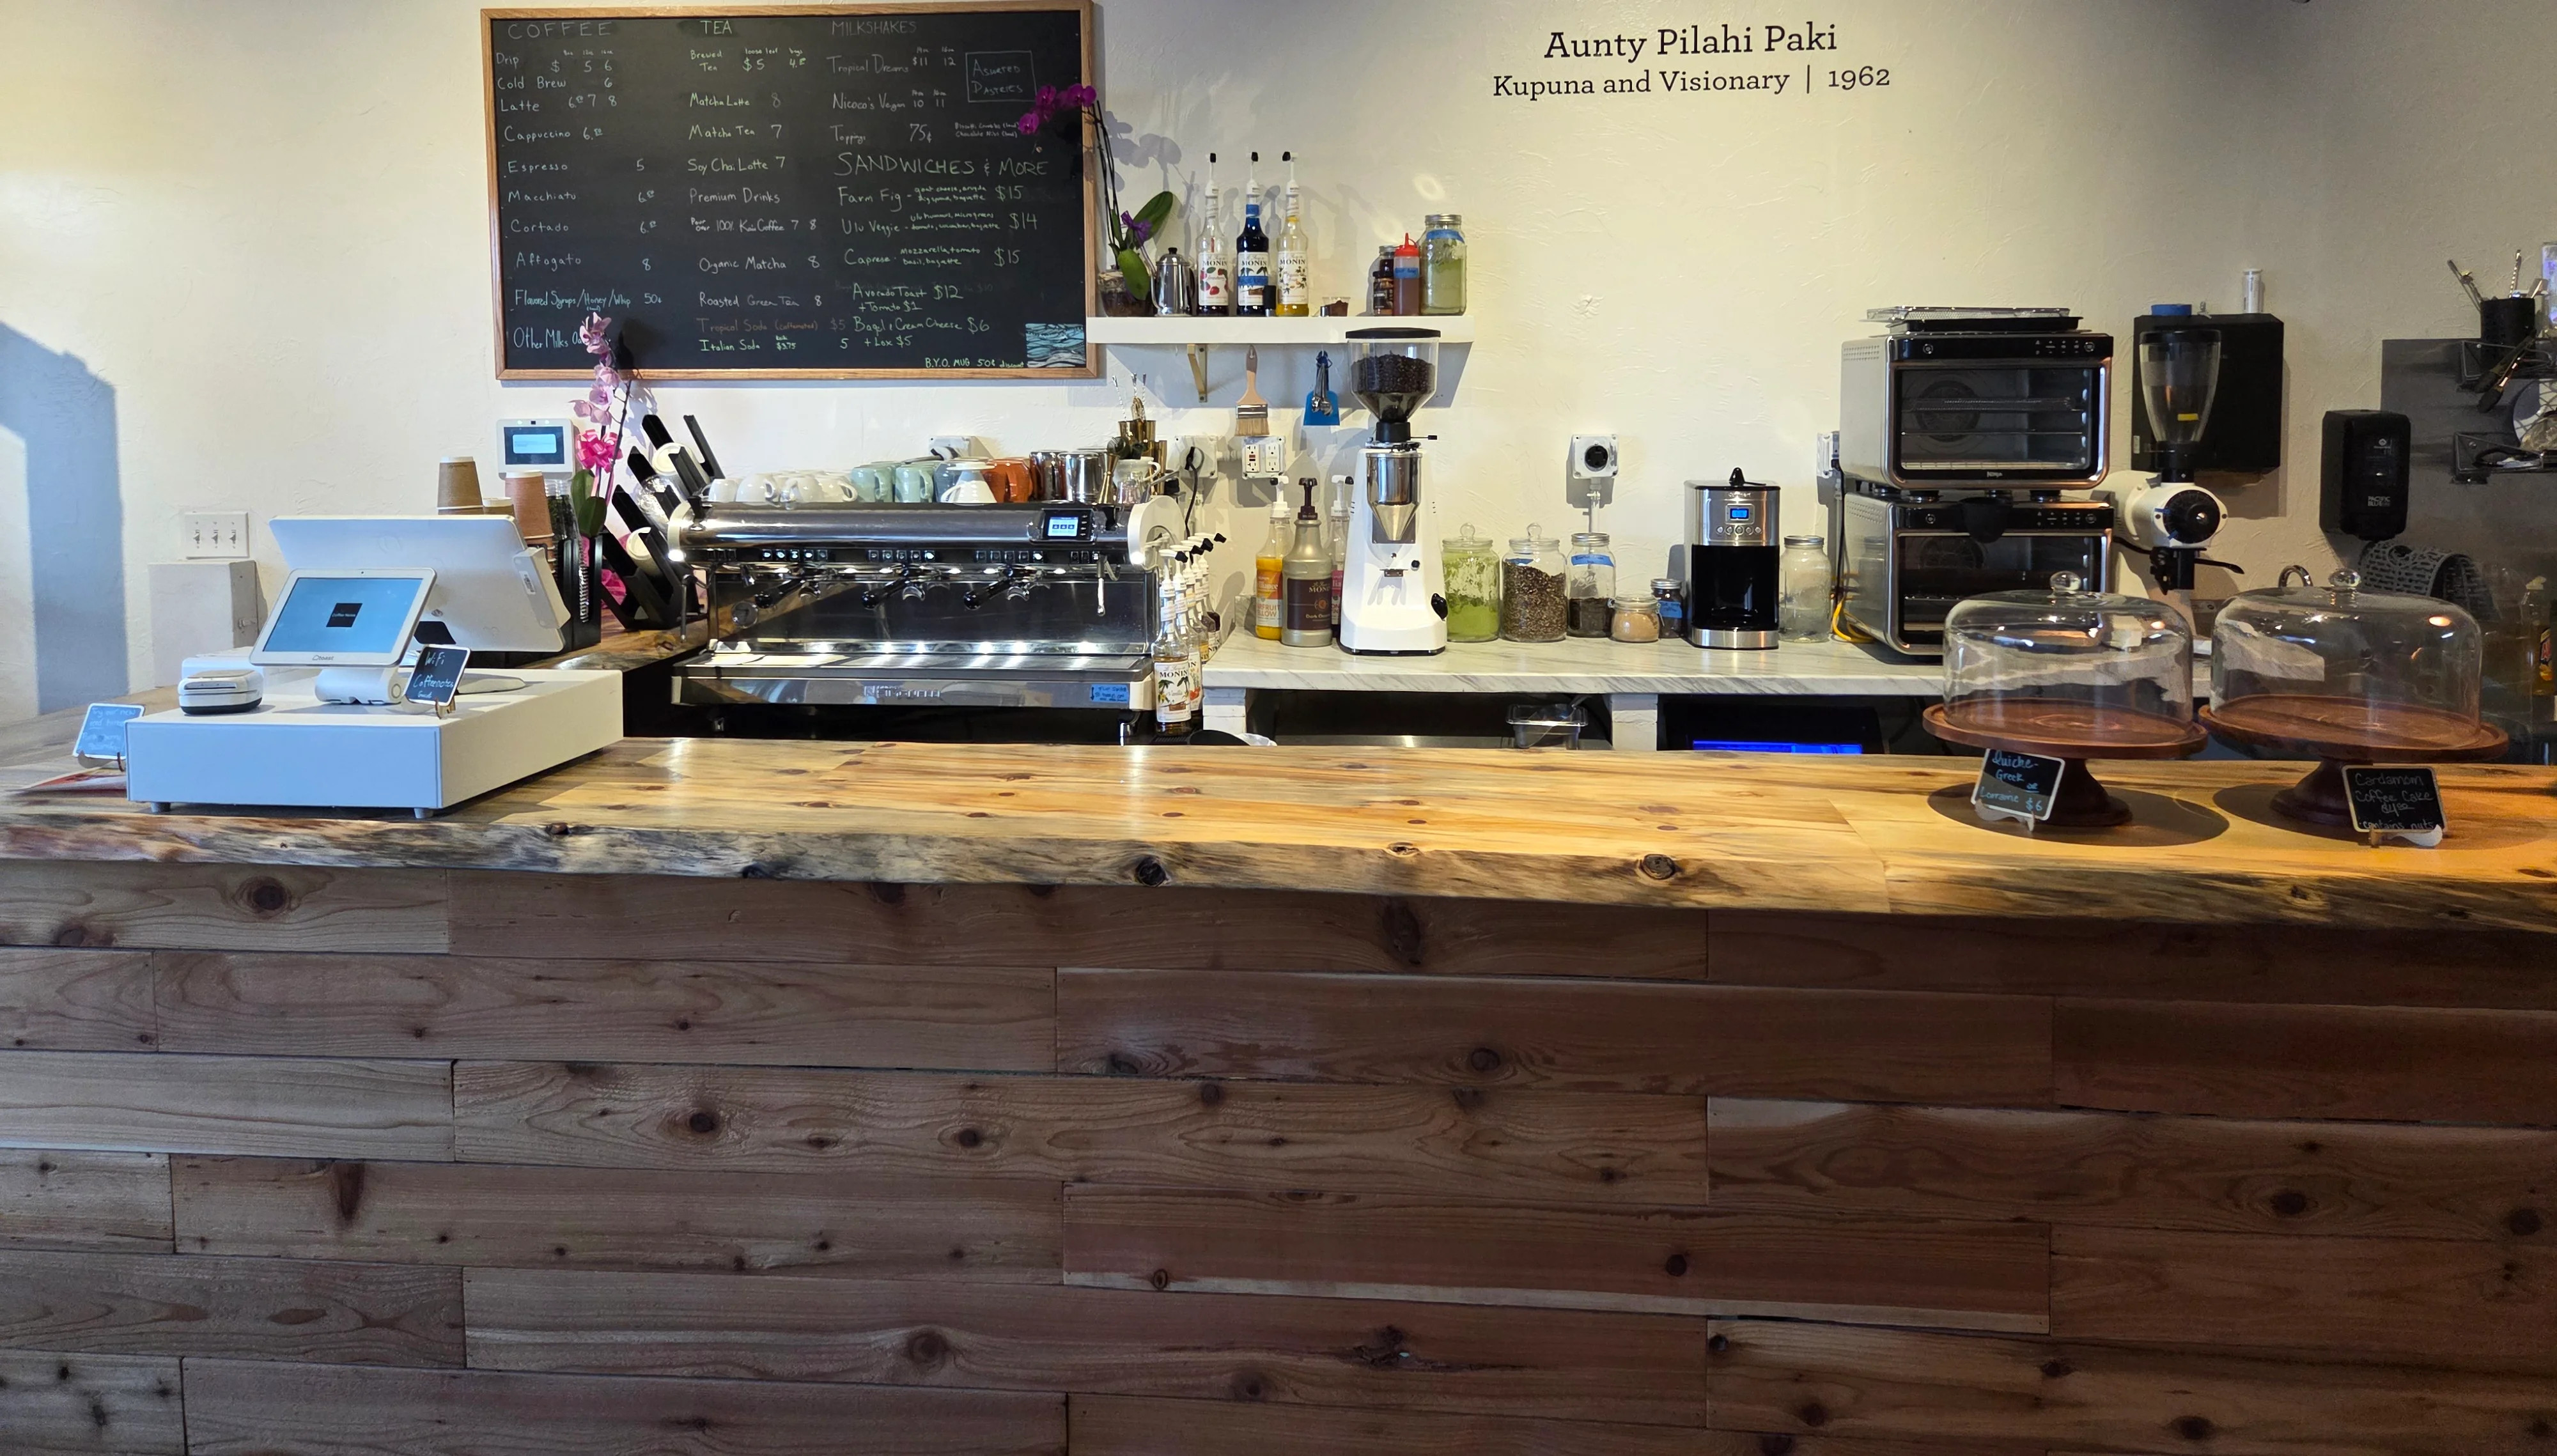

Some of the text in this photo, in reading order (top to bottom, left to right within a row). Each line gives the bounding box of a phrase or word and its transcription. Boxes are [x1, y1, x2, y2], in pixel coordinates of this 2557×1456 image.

[508, 22, 612, 40] COFFEE
[700, 20, 732, 35] TEA
[832, 20, 917, 36] MILKSHAKES
[1544, 22, 1837, 63] Aunty Pilahi Paki
[496, 52, 612, 73] Drip $ 5 6
[690, 50, 722, 60] Brewed
[699, 63, 717, 72] Tea
[826, 55, 868, 75] Tropical
[872, 54, 909, 74] Dreams
[944, 57, 956, 66] 12
[497, 75, 612, 89] Cold Brew 6
[1493, 66, 1890, 101] Kupuna and Visionary 1962
[501, 98, 540, 112] Latte
[587, 94, 596, 107] 7
[609, 96, 618, 107] 8
[690, 92, 781, 109] Matcha Latte 8
[832, 92, 874, 110] Nicoco's
[878, 93, 905, 111] Vegan
[504, 125, 571, 143] Cappuccino
[688, 124, 782, 141] Matcha Tea 7
[830, 124, 866, 144] Toppings
[508, 159, 644, 173] Espresso 5
[688, 156, 785, 175] Soy Chai Latte 7
[834, 152, 974, 176] SANDWICHES
[999, 157, 1048, 177] MORE
[508, 190, 576, 203] Macchiato
[690, 187, 780, 205] Premium Drinks
[837, 184, 1024, 212] Farm Fig $15
[511, 219, 569, 233] Cortado
[757, 217, 785, 231] Coffee
[791, 220, 799, 230] 7
[809, 219, 816, 230] 8
[841, 212, 1037, 238] Ulu Veggie $14
[517, 252, 651, 272] Affogato 8
[745, 256, 786, 270] Matcha
[808, 256, 820, 268] 8
[844, 247, 1020, 267] Caprese $15
[515, 289, 548, 306] Flavored
[699, 291, 822, 308] Roasted Green Tea 8
[853, 283, 895, 300] Avocado
[892, 286, 927, 297] Toast
[933, 285, 964, 300] $12
[903, 300, 923, 312] $1
[696, 318, 738, 334] Tropical
[744, 319, 767, 331] Soda
[853, 316, 990, 336] Bagel Cream Cheese $6
[514, 327, 568, 349] Other Milks
[698, 339, 734, 352] Italian
[739, 339, 760, 350] Soda
[839, 337, 849, 349] 5
[874, 336, 893, 346] Lox
[896, 335, 913, 348] $5
[954, 358, 970, 367] MUG
[424, 651, 446, 667] WiFi
[1160, 669, 1188, 678] MONIN
[1995, 768, 2025, 782] Greek
[2355, 773, 2424, 786] Cardamom
[2355, 789, 2436, 803] Coffee Cake
[2025, 798, 2043, 812] $6
[2410, 819, 2434, 830] nuts
